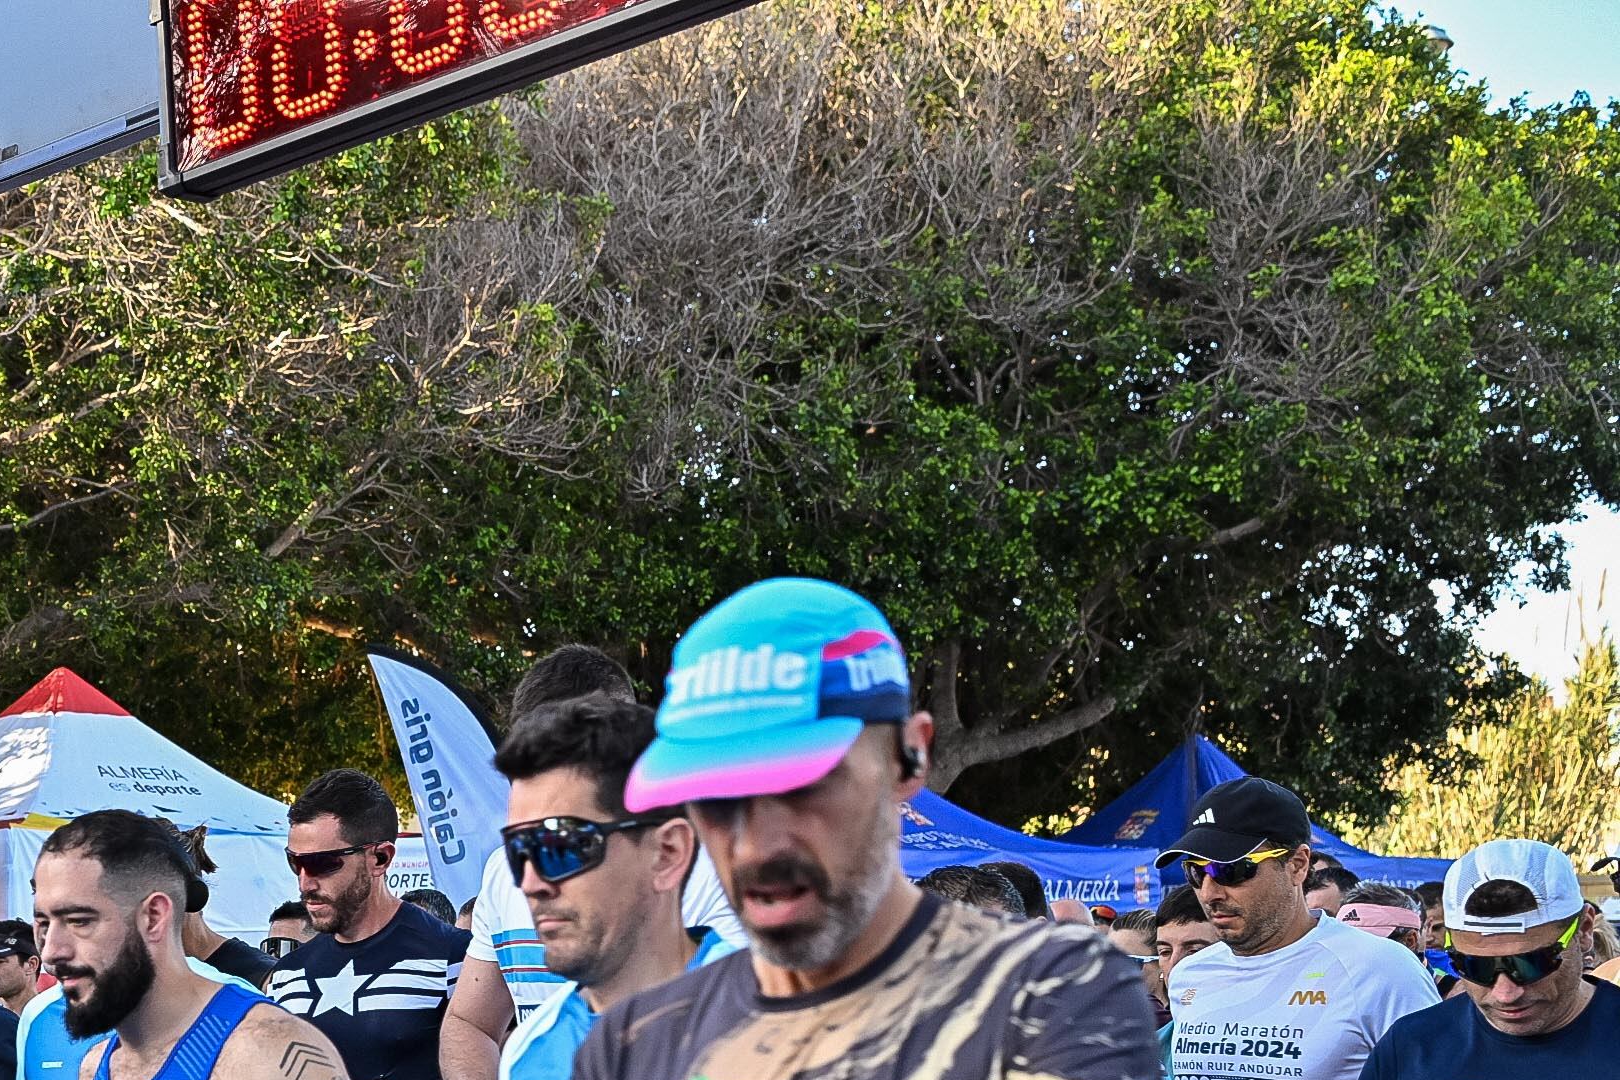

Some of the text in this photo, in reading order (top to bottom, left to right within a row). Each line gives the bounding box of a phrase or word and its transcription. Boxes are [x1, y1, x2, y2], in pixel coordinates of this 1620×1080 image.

[97, 765, 189, 782] ALMERÍA
[133, 781, 202, 796] deporte
[401, 860, 429, 868] MUNICIP
[1043, 873, 1121, 902] ALMERÍA
[1178, 1021, 1304, 1040] Medio Maratón
[1175, 1036, 1302, 1060] Almería 2024
[1207, 1061, 1235, 1072] RUIZ
[1238, 1062, 1303, 1078] ANDÚJAR
